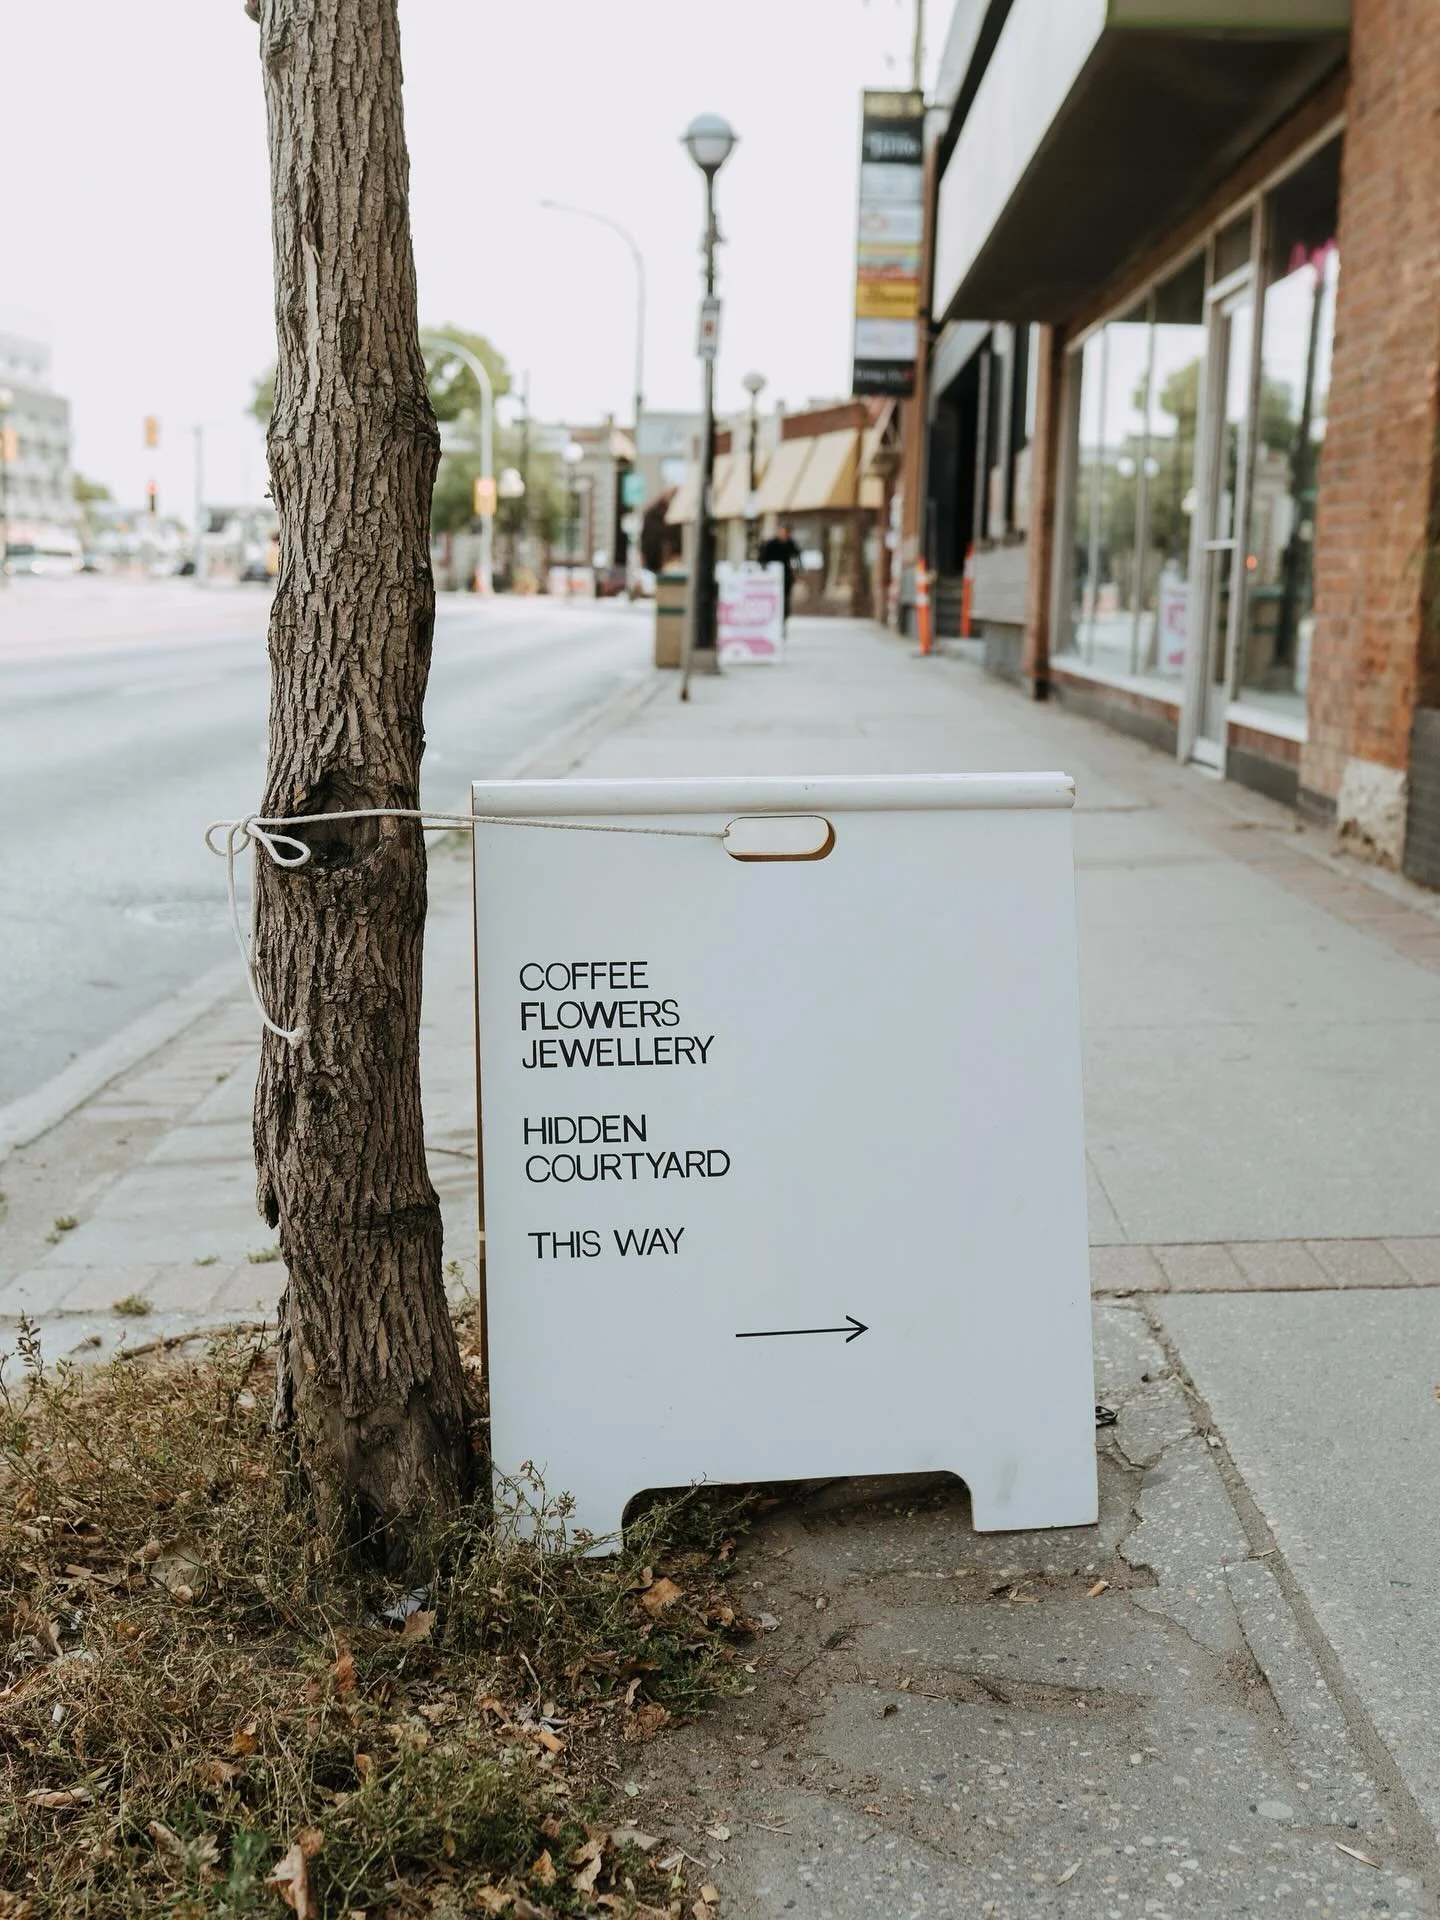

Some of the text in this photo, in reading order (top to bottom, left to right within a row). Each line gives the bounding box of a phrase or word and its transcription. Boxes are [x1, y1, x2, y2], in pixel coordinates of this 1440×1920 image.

[519, 960, 649, 991] COFFEE
[520, 998, 681, 1031] FLOWERS
[521, 1035, 716, 1069] JEWELLERY
[523, 1113, 647, 1145] HIDDEN
[525, 1149, 731, 1183] COURTYARD
[528, 1226, 685, 1259] THIS WAY
